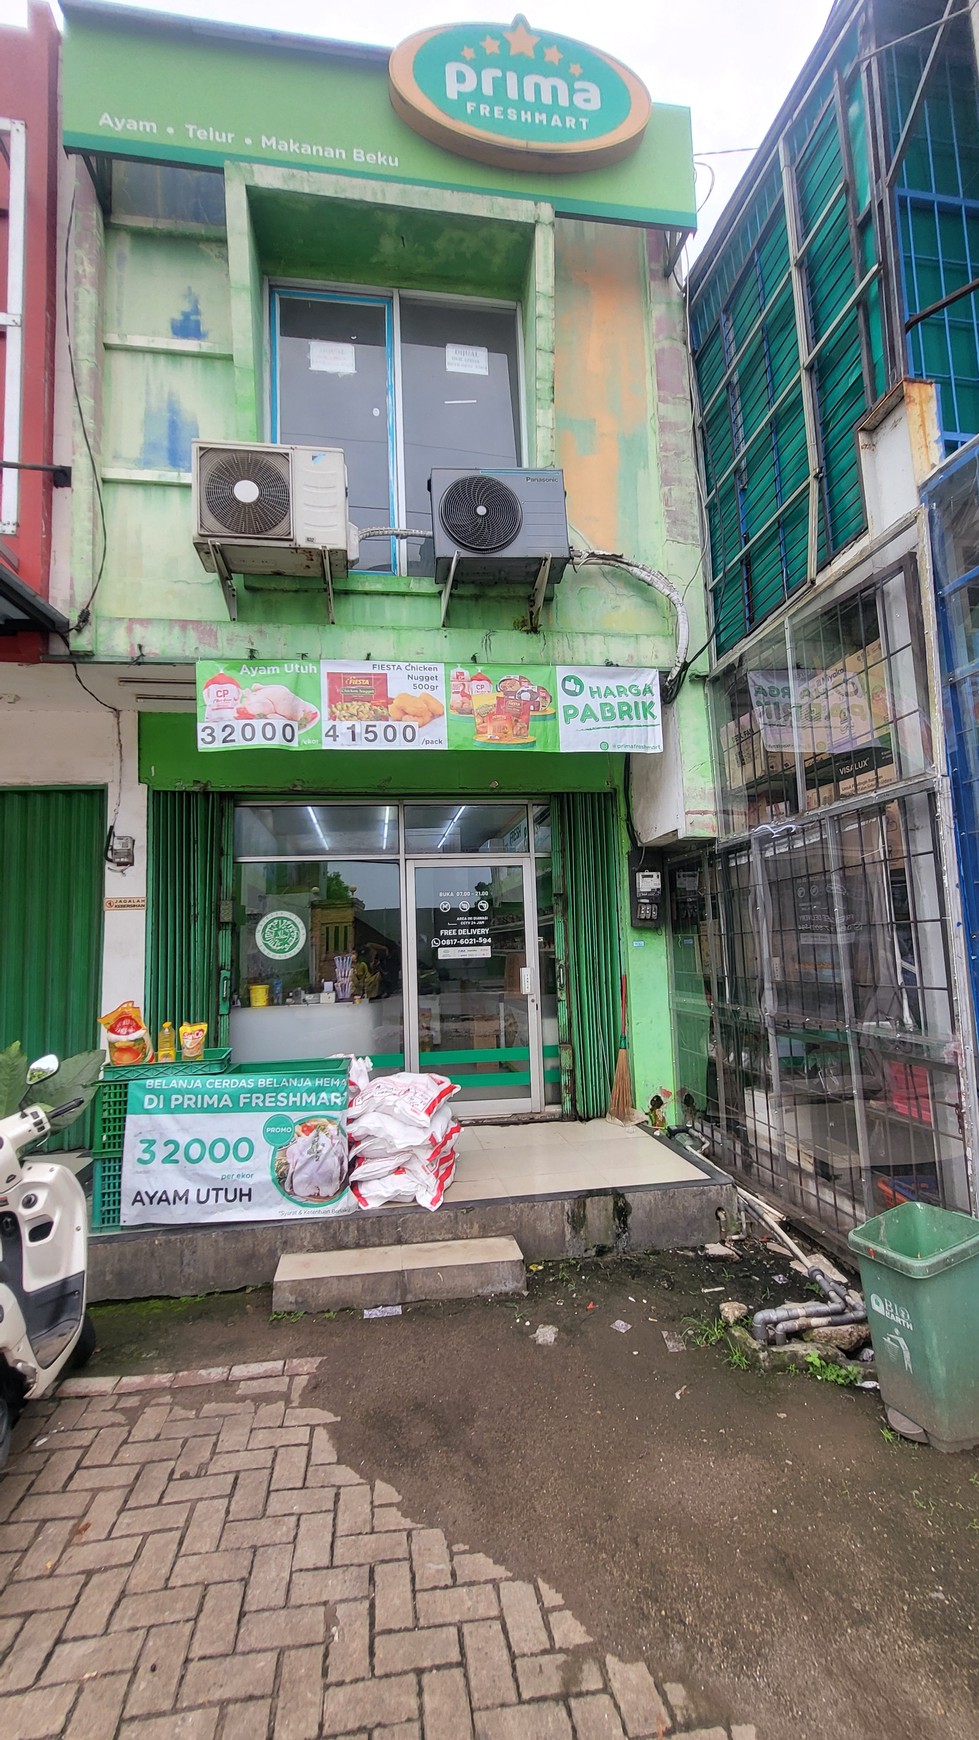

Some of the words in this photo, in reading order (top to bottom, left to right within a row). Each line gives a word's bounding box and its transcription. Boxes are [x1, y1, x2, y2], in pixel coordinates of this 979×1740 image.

[445, 61, 602, 111] prima
[466, 101, 590, 131] FRESHMART
[98, 112, 157, 132] Ayam
[185, 123, 235, 144] Telur
[261, 135, 347, 160] Makanan
[352, 147, 399, 167] Beku
[239, 664, 280, 677] Ayam
[284, 663, 318, 674] Utuh
[404, 664, 438, 672] Chicken
[407, 674, 439, 682] Nugget
[215, 689, 229, 698] CP
[588, 683, 655, 699] HARGA
[562, 701, 658, 725] PABRIK
[200, 722, 296, 745] 32000
[324, 723, 417, 743] 41500
[421, 738, 444, 746] /pack
[441, 937, 492, 945] 0817-6021-594
[145, 1079, 202, 1089] BELANJA
[206, 1078, 254, 1088] CERDAS
[257, 1078, 311, 1088] BELANJA
[143, 1094, 164, 1109] DI
[170, 1093, 233, 1109] PRIMA
[136, 1137, 255, 1166] 32000
[131, 1188, 190, 1206] AYAM
[196, 1187, 252, 1204] UTUH
